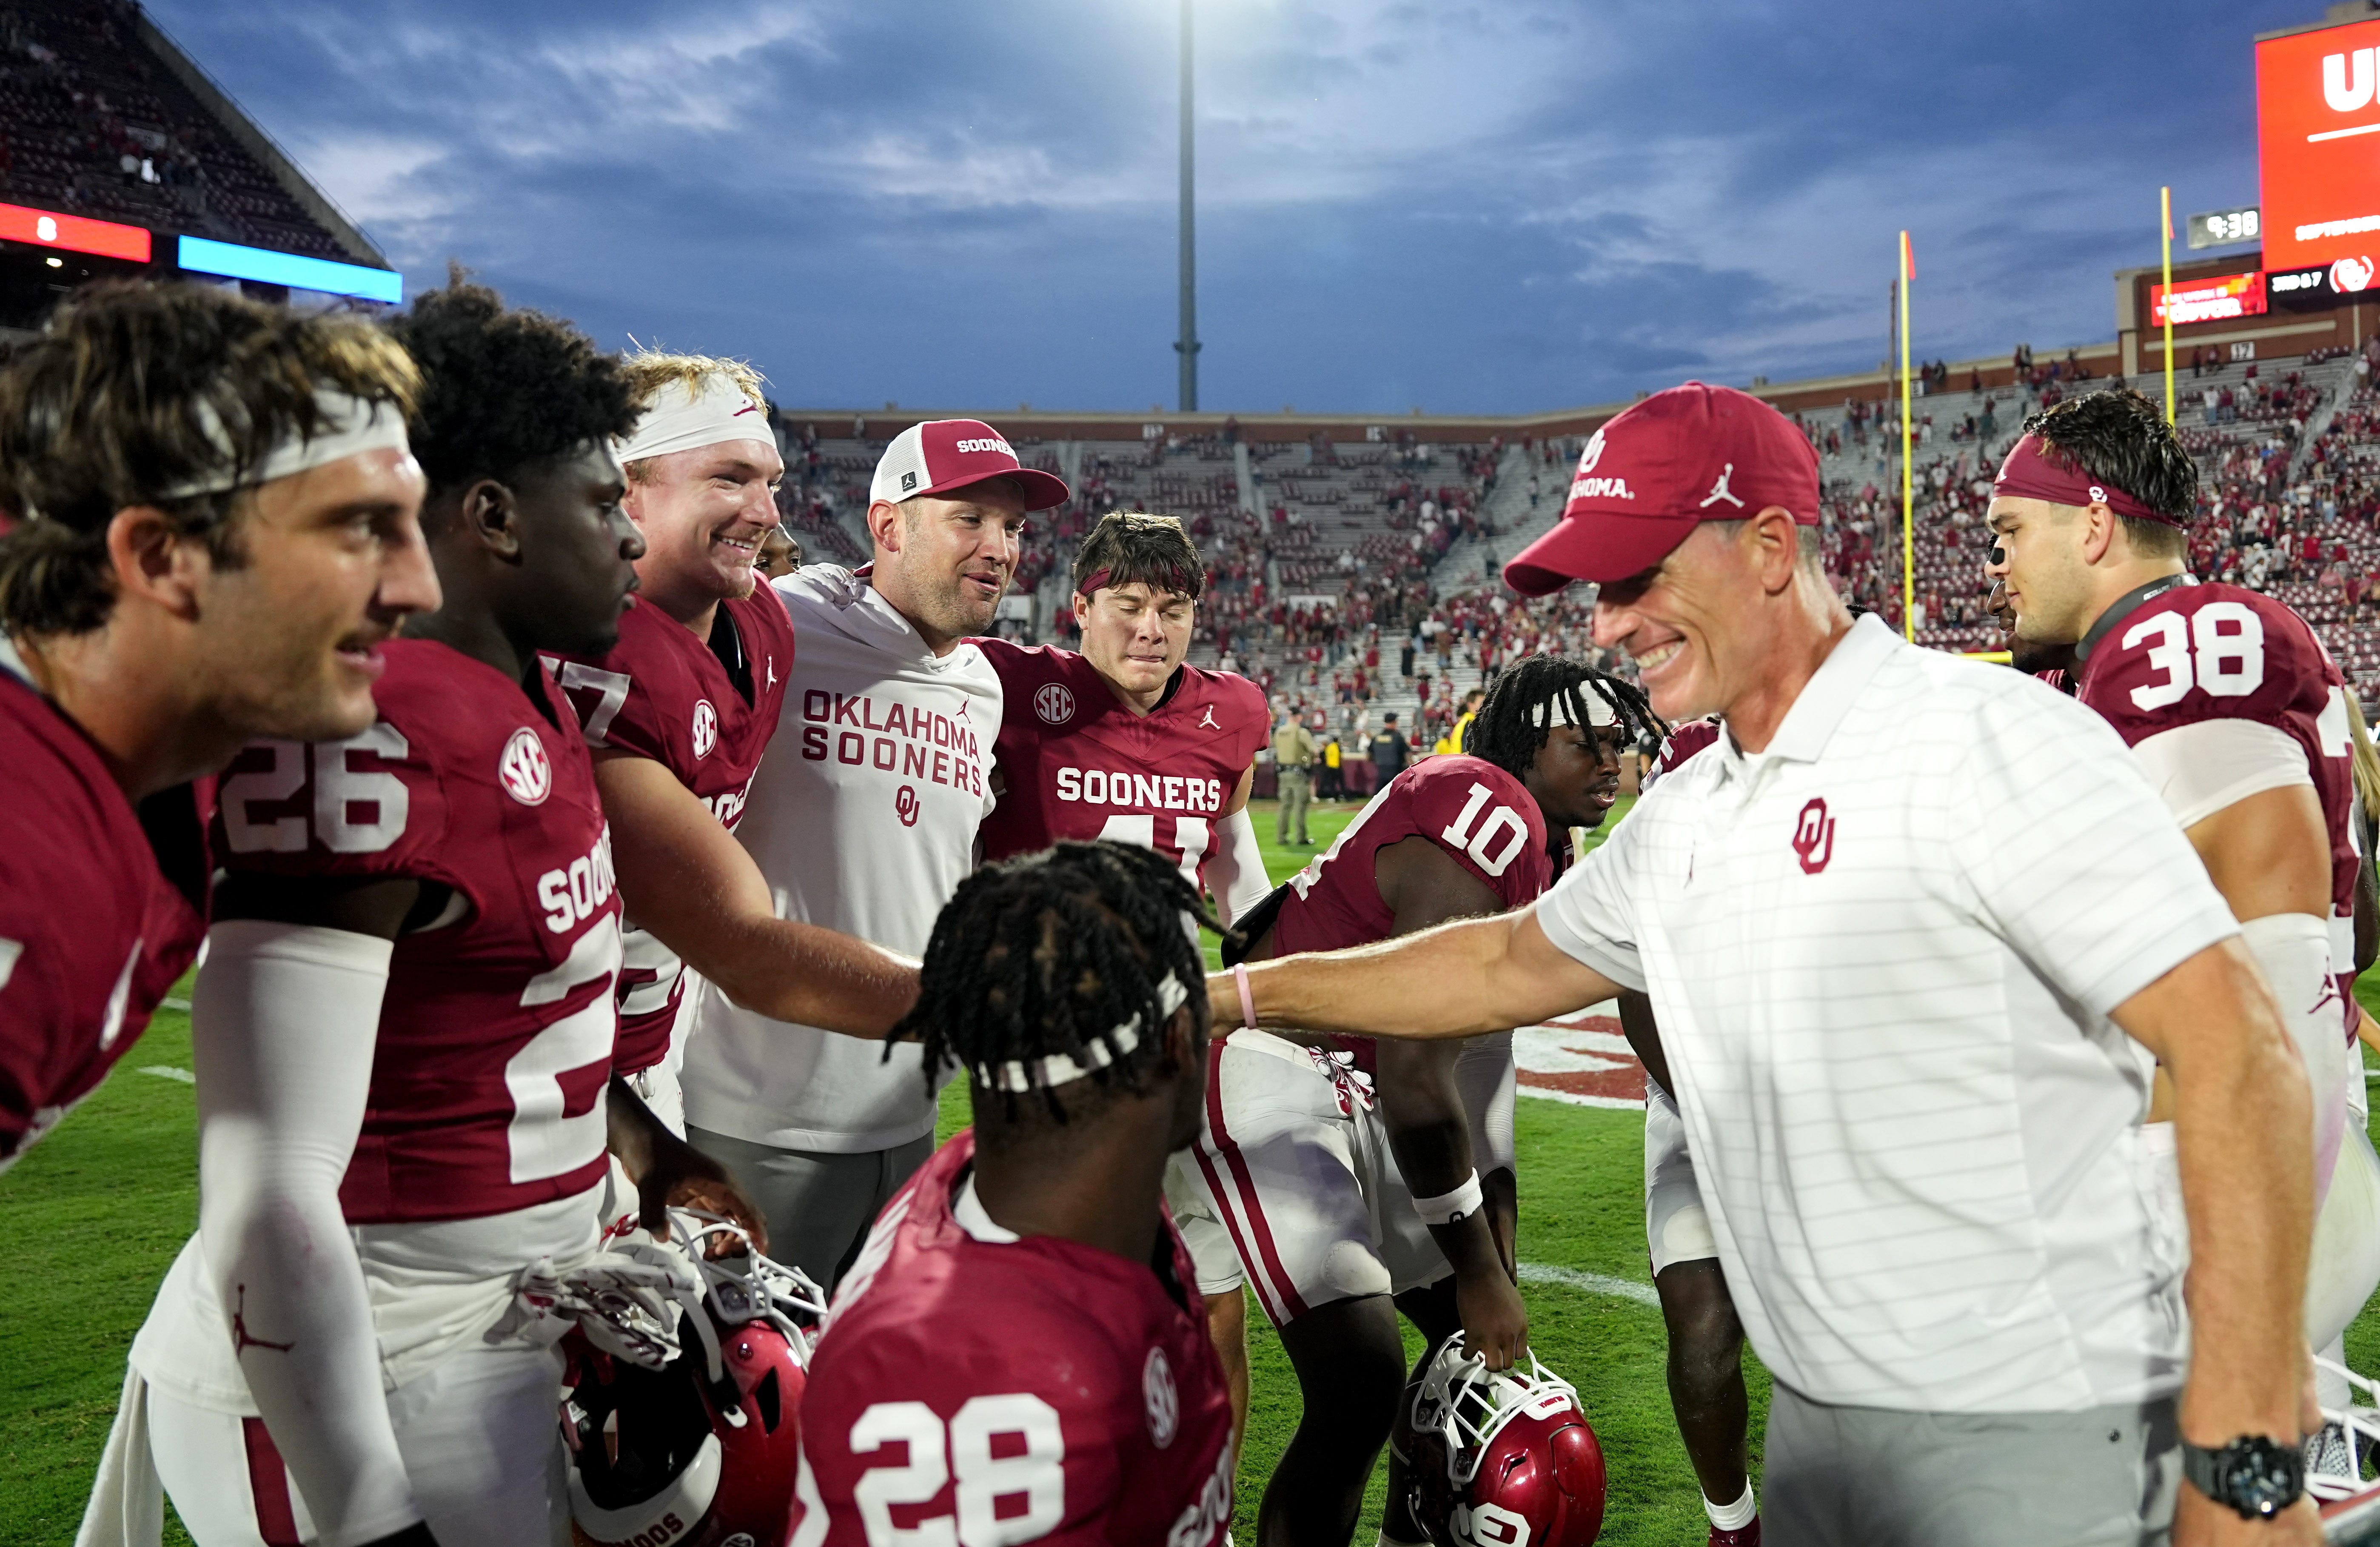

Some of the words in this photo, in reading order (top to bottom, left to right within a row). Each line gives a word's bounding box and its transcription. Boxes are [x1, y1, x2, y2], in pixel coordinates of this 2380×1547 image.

[2323, 47, 2380, 112] U
[37, 216, 57, 241] 8
[2207, 210, 2258, 239] 9:38
[2312, 271, 2322, 287] 7
[2122, 602, 2264, 711] 38
[539, 655, 631, 748] 7
[693, 702, 716, 757] SEC
[804, 689, 981, 764] OKLAHOMA
[1037, 686, 1072, 722] SEC
[220, 722, 409, 853] 26
[501, 732, 550, 803] SEC
[802, 727, 981, 797] SOONERS
[1057, 767, 1221, 811] SOONERS
[895, 785, 920, 827] OU
[1442, 782, 1528, 876] 10
[1792, 797, 1836, 875] OU
[849, 1392, 1065, 1547] 28
